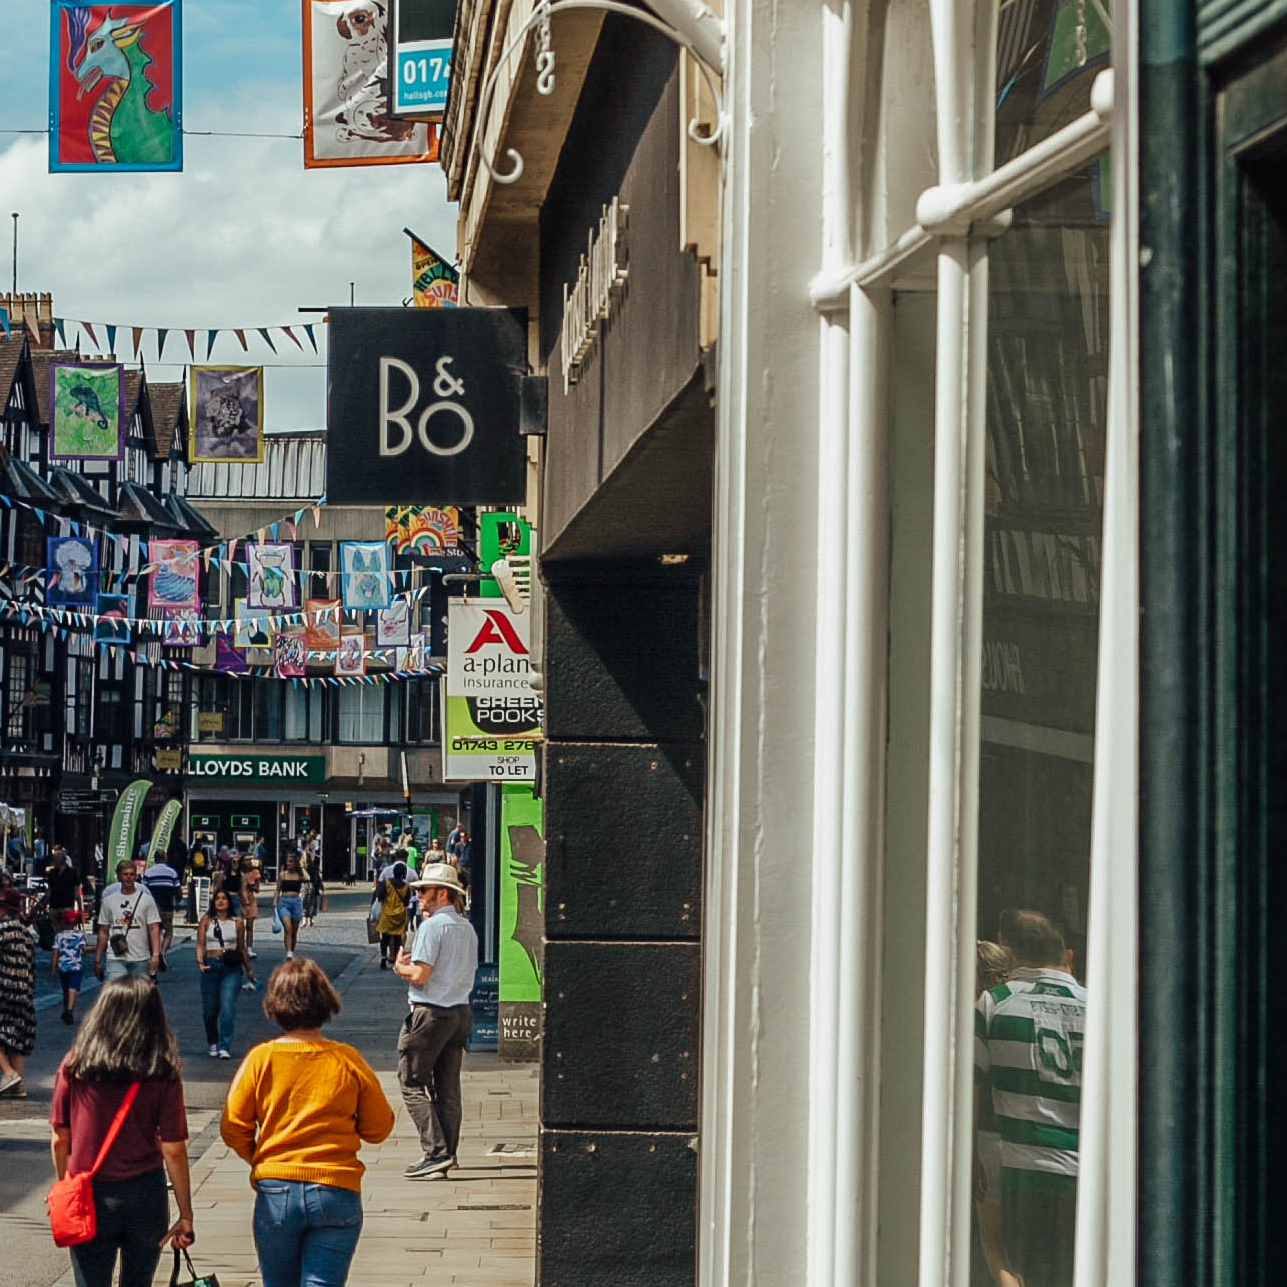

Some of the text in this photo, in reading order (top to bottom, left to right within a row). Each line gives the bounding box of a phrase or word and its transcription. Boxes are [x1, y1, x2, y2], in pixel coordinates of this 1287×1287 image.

[463, 653, 529, 676] a-plan
[463, 677, 529, 689] insurance
[452, 740, 498, 751] 01743
[497, 756, 520, 764] SHOP
[187, 760, 308, 777] LLOYDS BANK
[489, 766, 529, 776] TO LET
[116, 788, 138, 858] Shropshire
[502, 1015, 537, 1027] write
[503, 1027, 532, 1038] here
